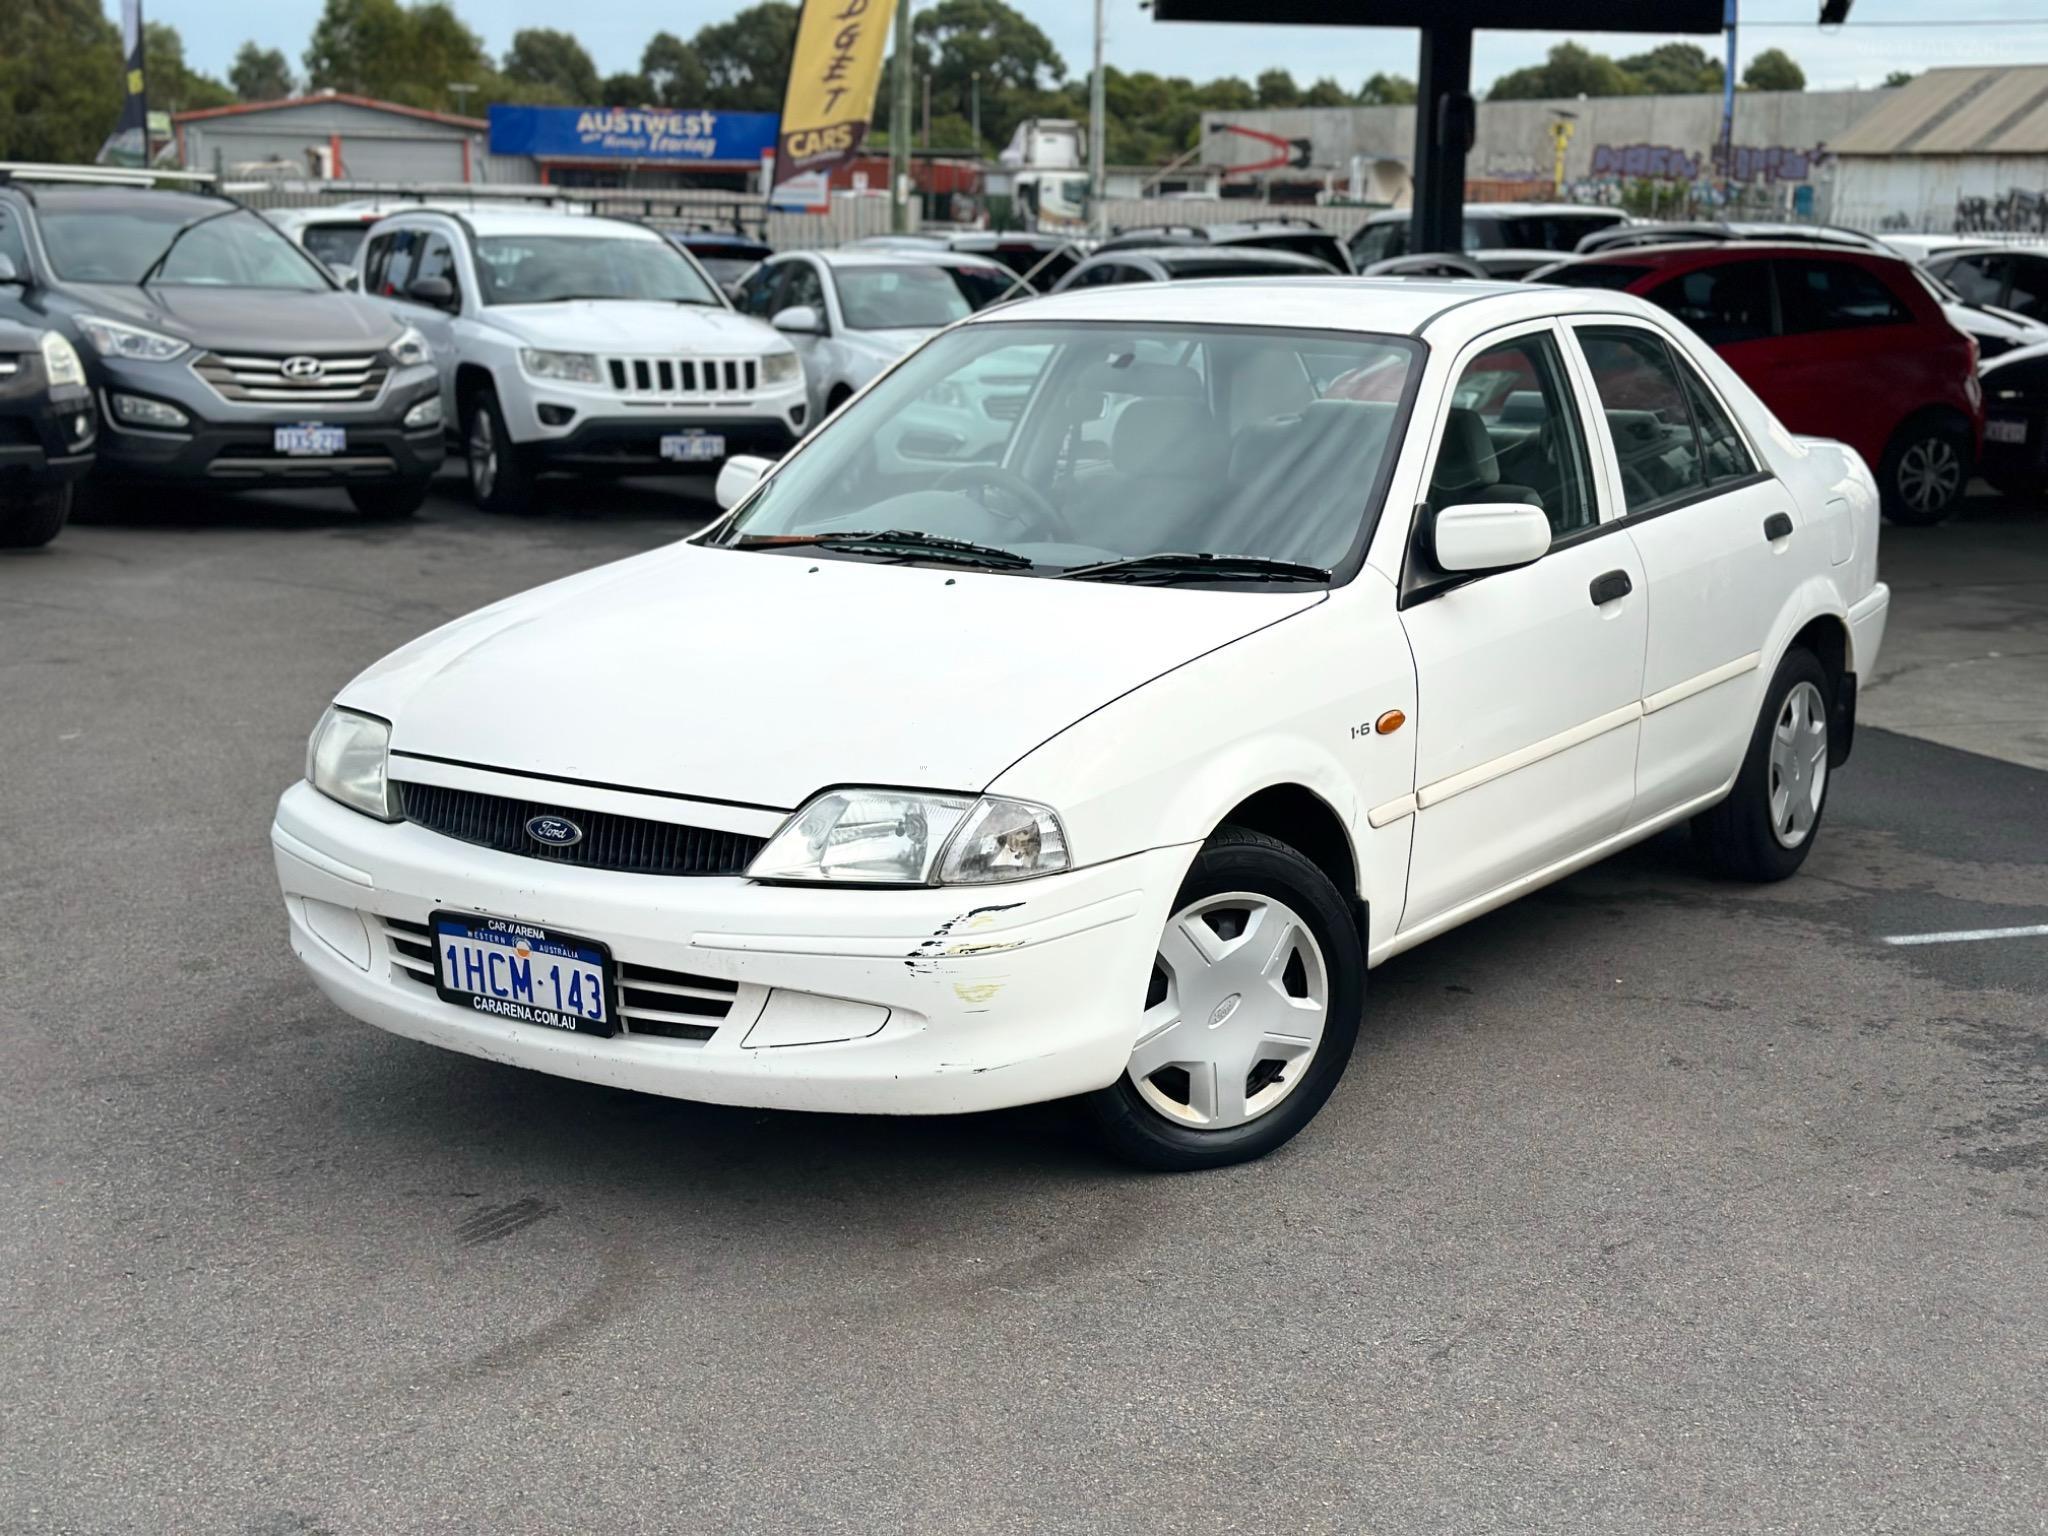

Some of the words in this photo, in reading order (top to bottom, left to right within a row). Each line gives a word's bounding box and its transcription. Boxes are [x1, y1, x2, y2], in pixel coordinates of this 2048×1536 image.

[576, 111, 716, 136] AUSTWEST
[787, 124, 853, 159] CARS
[537, 820, 568, 839] Ford
[488, 920, 507, 933] CAR
[515, 925, 546, 941] ARENA
[467, 931, 506, 945] WESTERN
[539, 944, 579, 959] AUSTRALIA
[473, 996, 576, 1030] CARARENA.COM.AU
